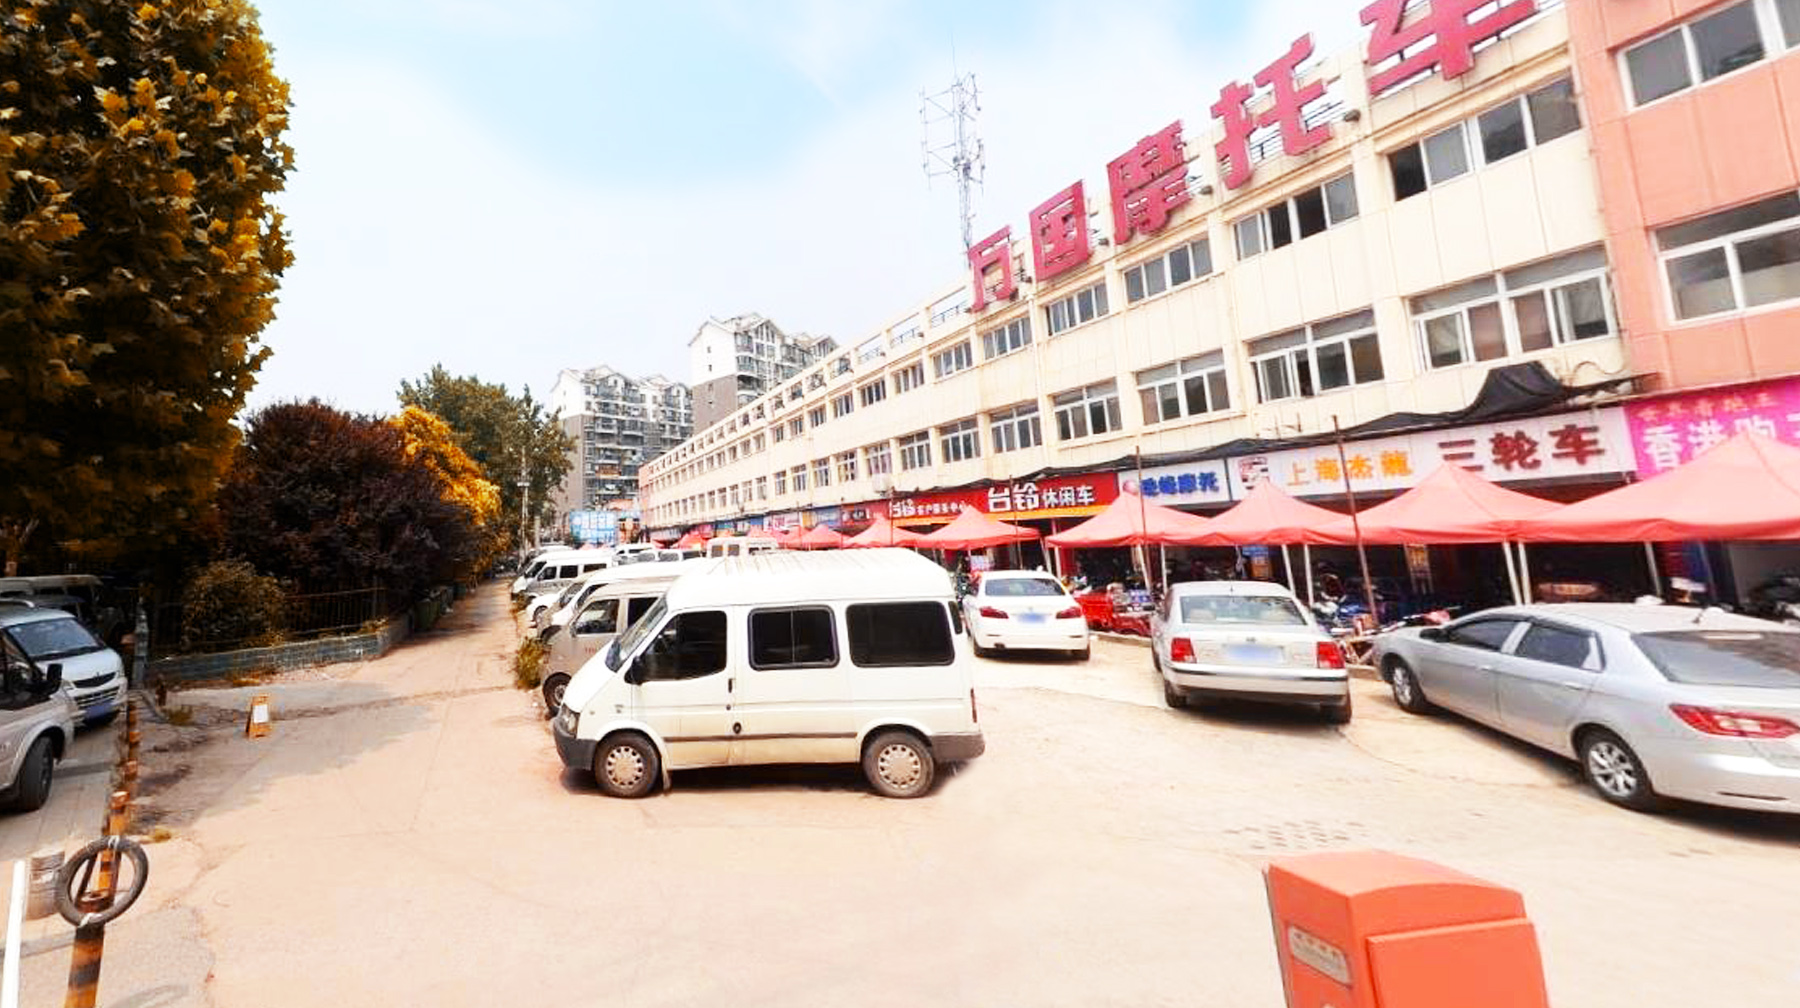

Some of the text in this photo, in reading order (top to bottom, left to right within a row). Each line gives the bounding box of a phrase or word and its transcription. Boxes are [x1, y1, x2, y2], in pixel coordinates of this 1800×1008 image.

[966, 0, 1538, 313] 万国摩托车
[1437, 424, 1606, 471] 三轮车
[987, 481, 1095, 512] 台铃 休闲车
